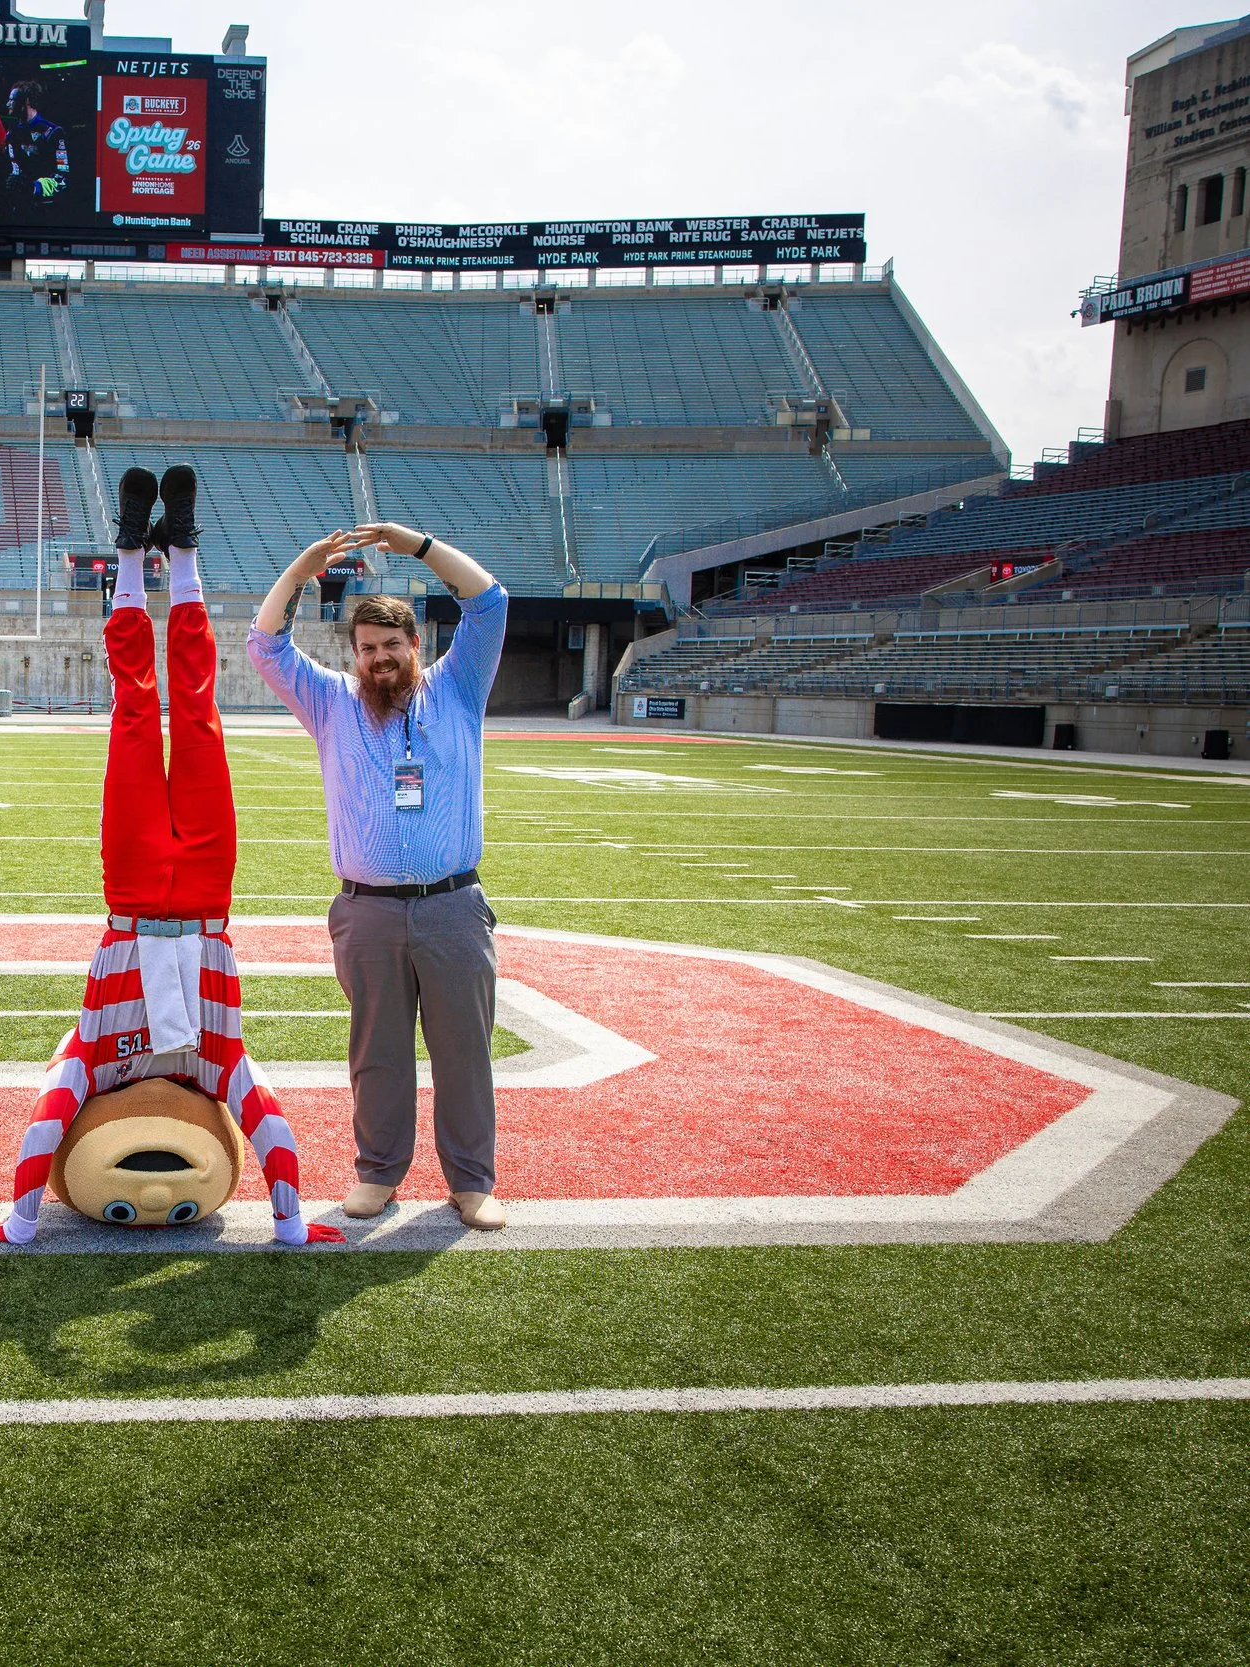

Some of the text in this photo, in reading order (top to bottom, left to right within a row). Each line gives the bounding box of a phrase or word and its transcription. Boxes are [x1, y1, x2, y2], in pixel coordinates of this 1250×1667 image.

[116, 61, 191, 78] NETJETS
[217, 68, 263, 80] DEFEND
[228, 79, 252, 90] THE
[222, 89, 256, 100] 'SHOE
[144, 98, 180, 109] BUCKEYE
[1144, 119, 1182, 139] William
[106, 117, 189, 154] Spring
[1173, 127, 1215, 148] Stadium
[185, 140, 202, 151] '26
[125, 144, 197, 175] Game
[132, 187, 174, 195] MORTGAGE
[125, 215, 191, 227] Huntington Bank
[280, 221, 321, 233] BLOCH
[686, 219, 750, 231] WEBSTER
[761, 218, 820, 229] CRABILL
[337, 223, 379, 235] CRANE
[395, 226, 443, 236] PHIPPS
[459, 225, 528, 237] McCORKLE
[545, 221, 674, 235] HUNTINGTON BANK
[806, 228, 865, 240] NETJETS
[290, 233, 370, 246] SCHUMAKER
[533, 235, 586, 247] NOURSE
[612, 233, 655, 245] PRIOR
[669, 231, 731, 243] RITE RUG
[740, 230, 796, 242] SAVAGE
[398, 237, 503, 248] O'SHAUGHNESSY
[181, 247, 373, 264] NEED ASSISTANCE? TEXT 845-723-3326
[538, 252, 599, 264] HYDE PARK
[623, 249, 753, 261] HYDE PARK PRIME STEAKHOUSE
[776, 245, 841, 259] HYDE PARK
[392, 255, 515, 266] HYDE PARK PRIME STEAKHOUSE
[1101, 290, 1134, 313] PAUL
[1136, 277, 1185, 305] BROWN
[70, 393, 85, 407] 22
[327, 567, 356, 575] TOYOTA
